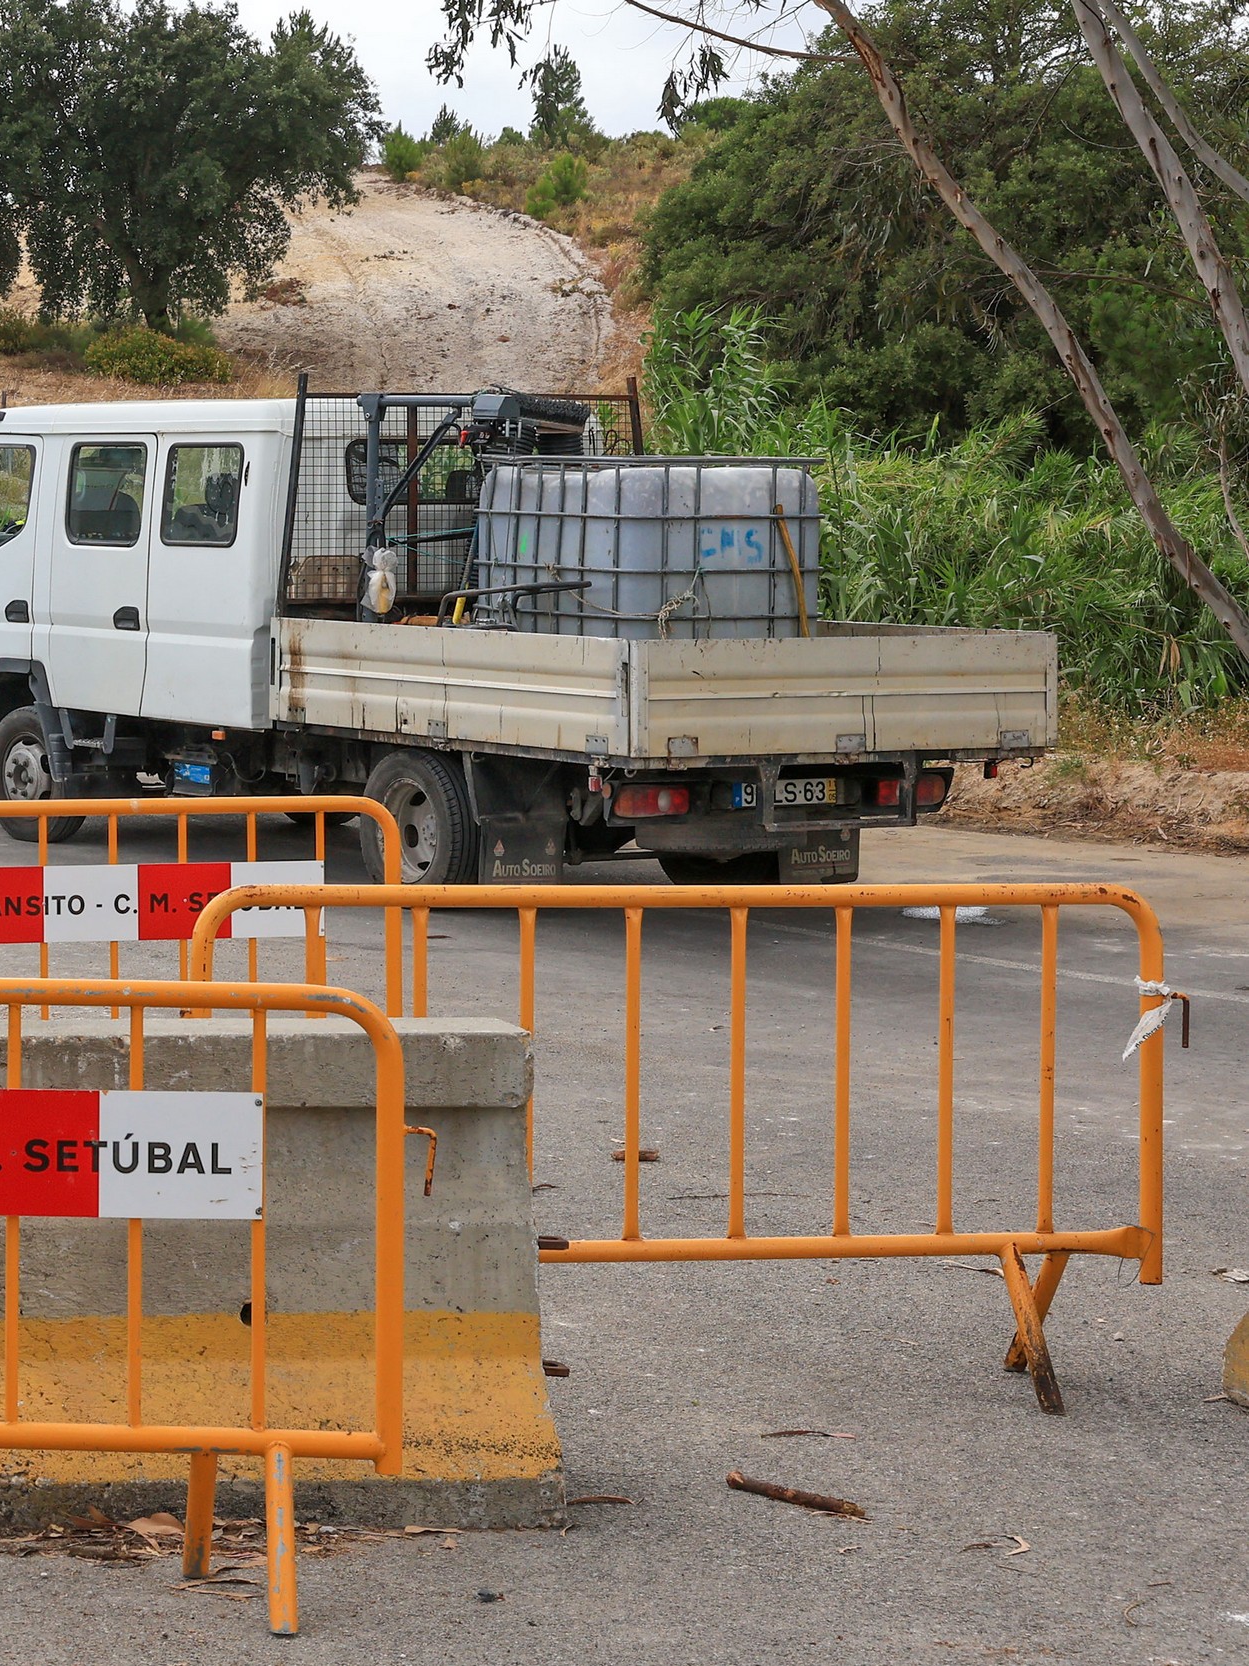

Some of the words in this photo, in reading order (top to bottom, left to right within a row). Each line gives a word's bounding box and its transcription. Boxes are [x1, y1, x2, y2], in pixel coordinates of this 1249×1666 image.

[113, 893, 138, 914] C.
[150, 893, 177, 913] M.
[23, 1133, 232, 1175] SETÚBAL
